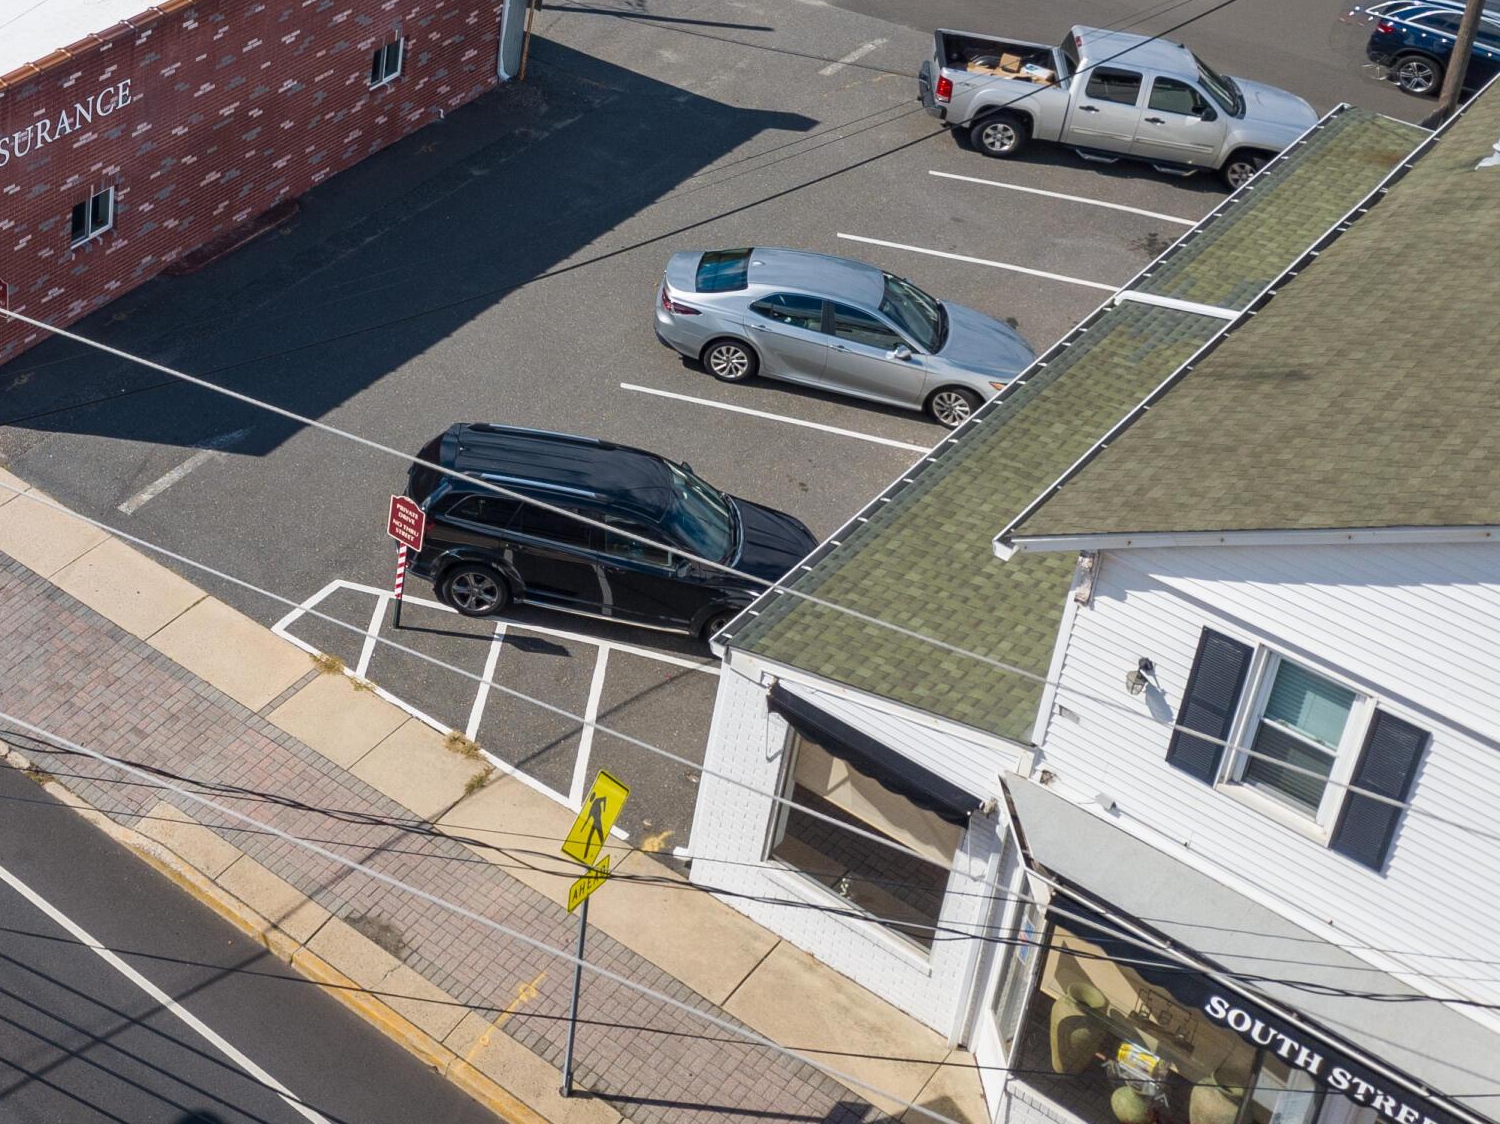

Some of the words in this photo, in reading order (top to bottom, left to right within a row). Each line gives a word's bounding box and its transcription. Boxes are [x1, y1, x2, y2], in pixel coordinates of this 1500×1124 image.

[396, 503, 418, 520] PRIVATE
[398, 511, 415, 525] DRIVE
[393, 518, 403, 528] NO
[403, 524, 419, 537] THRU
[396, 527, 415, 542] STREET
[1204, 995, 1323, 1075] SOUTH
